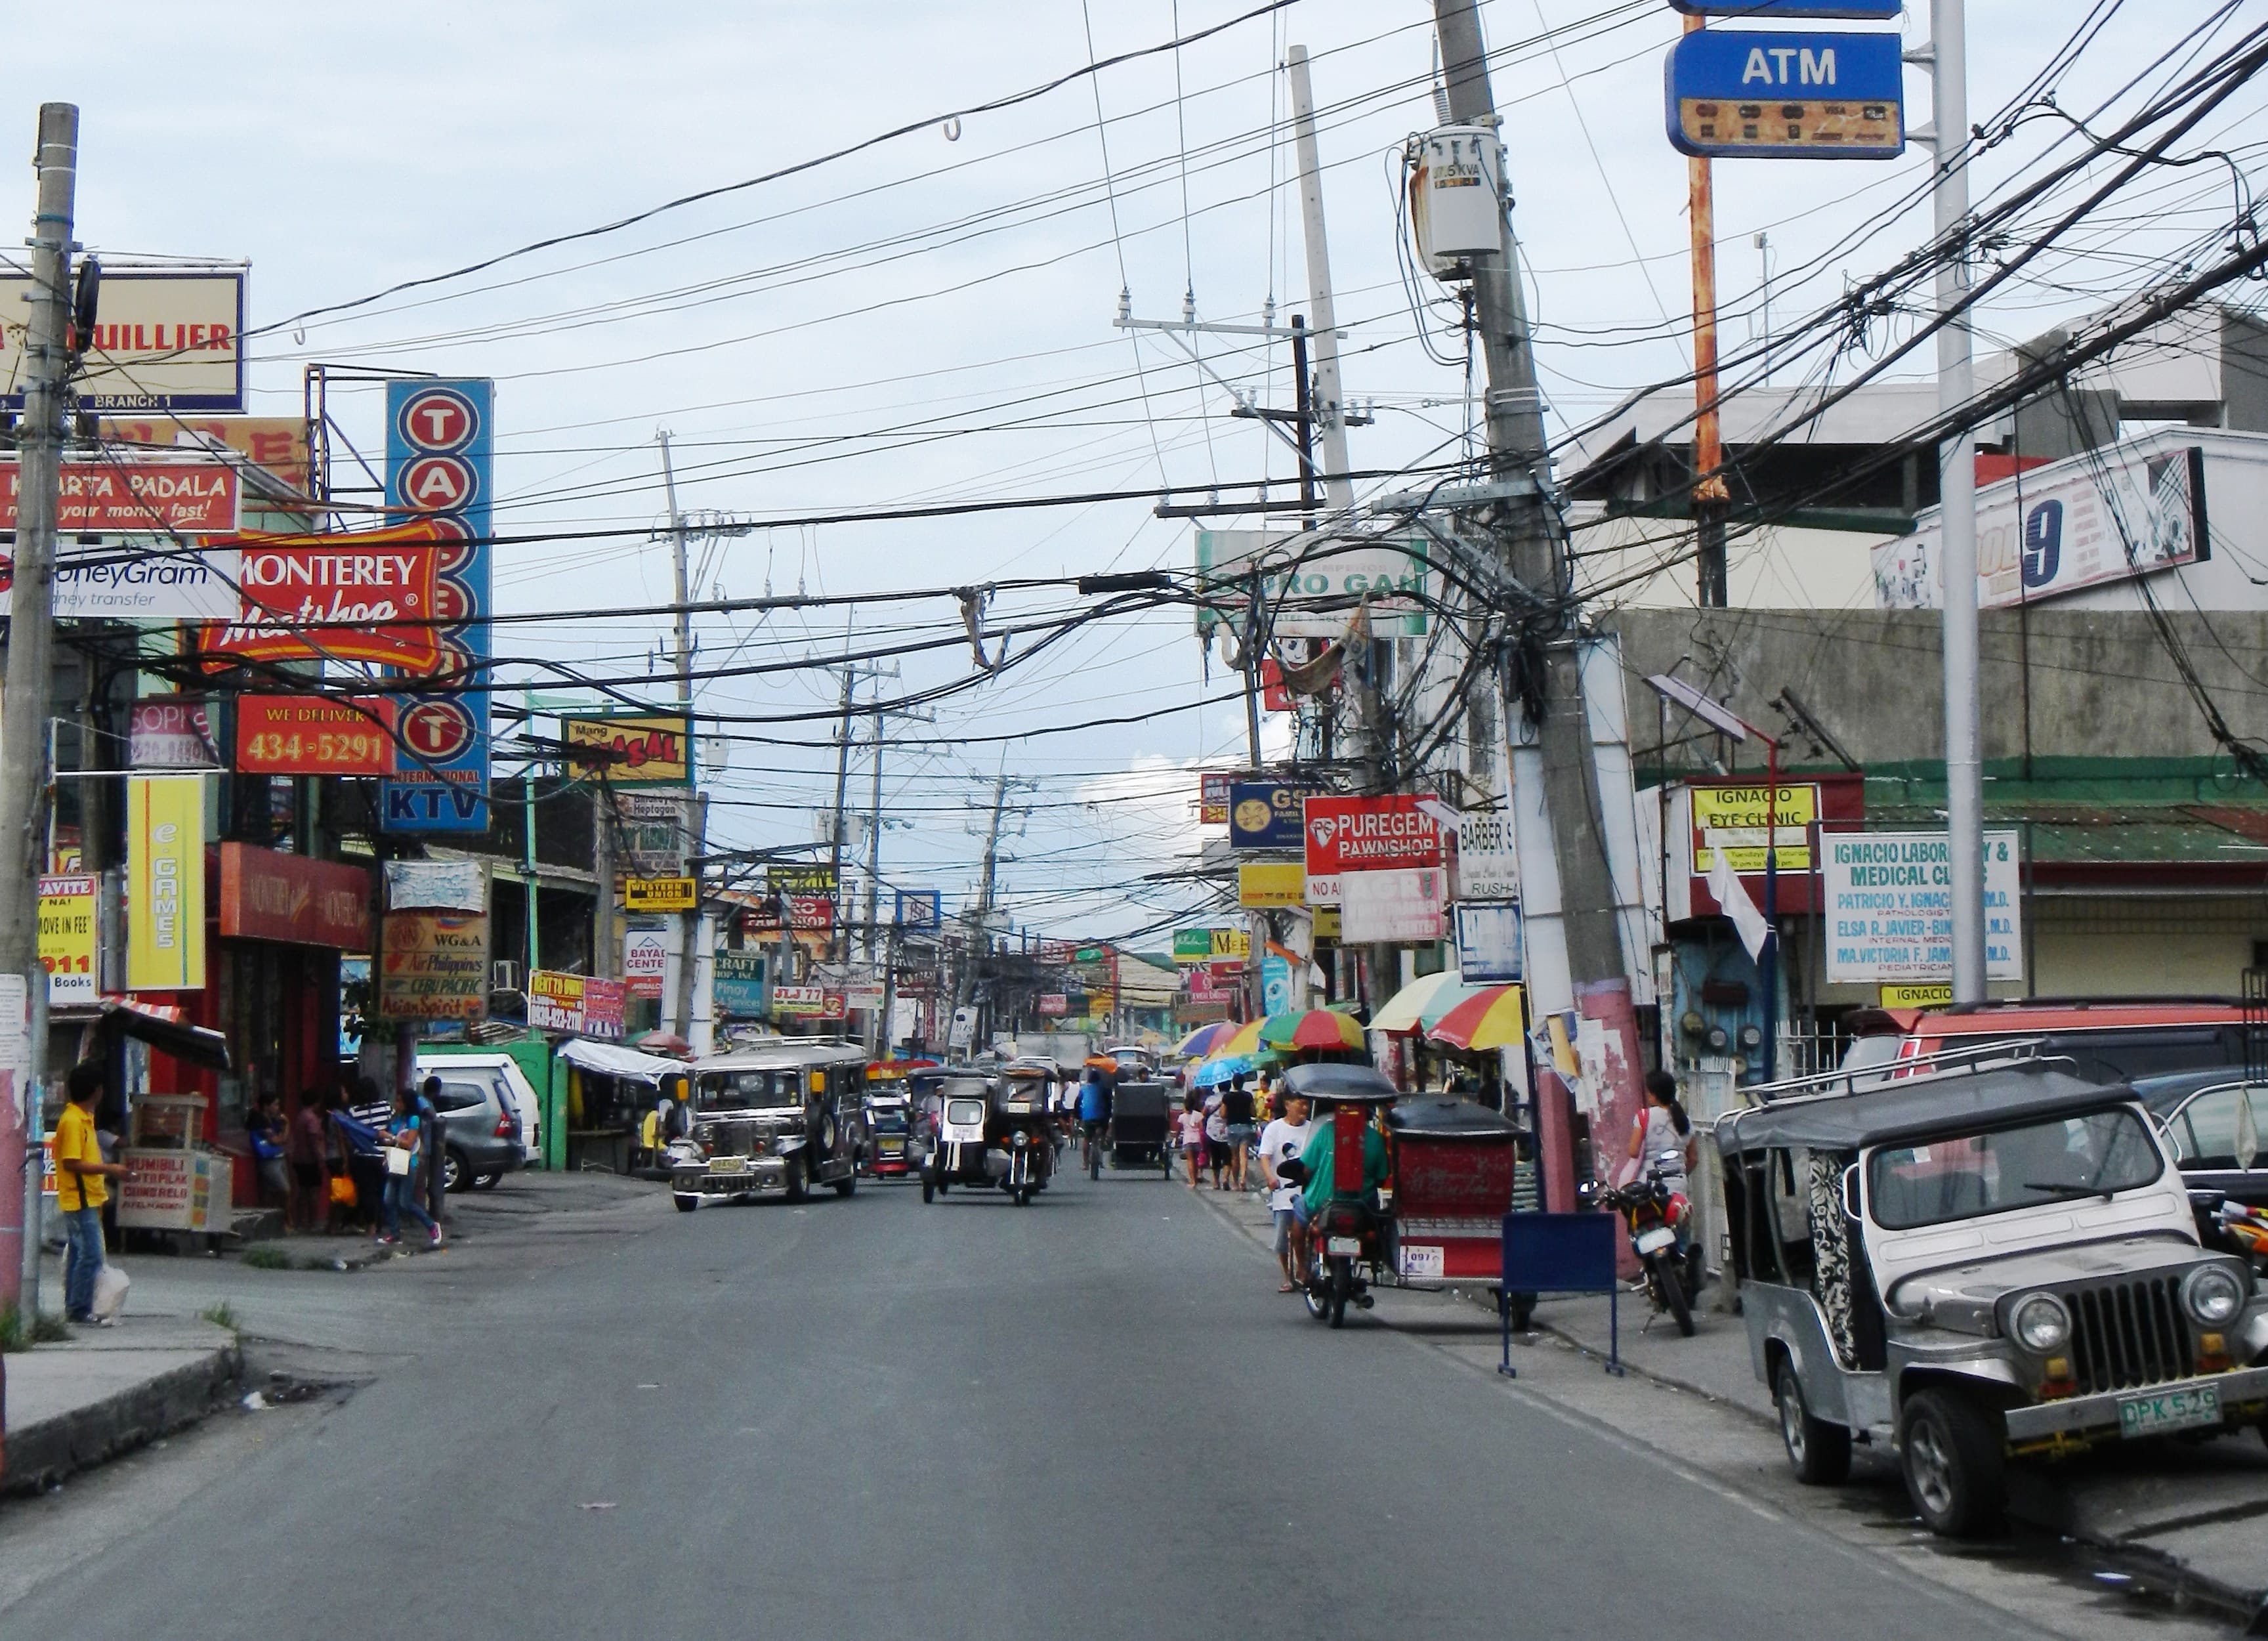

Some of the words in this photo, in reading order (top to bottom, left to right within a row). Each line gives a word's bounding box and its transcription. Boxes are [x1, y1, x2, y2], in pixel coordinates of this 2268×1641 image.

[1742, 48, 1837, 85] ATM
[95, 394, 158, 408] BRANCH
[165, 394, 171, 407] 1
[130, 474, 226, 497] PADALA
[60, 505, 99, 521] your
[107, 505, 165, 522] money
[170, 500, 212, 518] fast!
[2023, 499, 2063, 588] 9
[91, 591, 156, 606] transfer
[219, 589, 398, 647] Meatshop
[267, 709, 290, 721] WE
[299, 709, 366, 723] DELIVER
[576, 725, 608, 736] Mang
[247, 733, 383, 762] 434-5291
[389, 788, 481, 820] KTV
[1716, 790, 1792, 803] IGNACIO
[634, 805, 675, 816] Heptagon
[1338, 812, 1433, 838] PUREGEM
[1710, 813, 1739, 826] EYE
[1461, 822, 1502, 851] BARBER
[1339, 838, 1434, 859] PAWNSHOP
[1835, 842, 1899, 864] IGNACIO
[1996, 841, 2009, 862] &
[1850, 866, 1928, 887] MEDICAL
[631, 882, 682, 891] WESTERN
[1313, 881, 1328, 895] NO
[1838, 893, 1895, 909] PATRICIO
[62, 916, 72, 934] IN
[1838, 921, 1866, 937] ELSA
[434, 933, 481, 947] WG&A
[427, 954, 482, 975] Philippines
[54, 977, 91, 987] Books
[440, 979, 481, 994] PACIFIC
[806, 989, 821, 1000] 77
[1897, 988, 1952, 1000] IGNACIO
